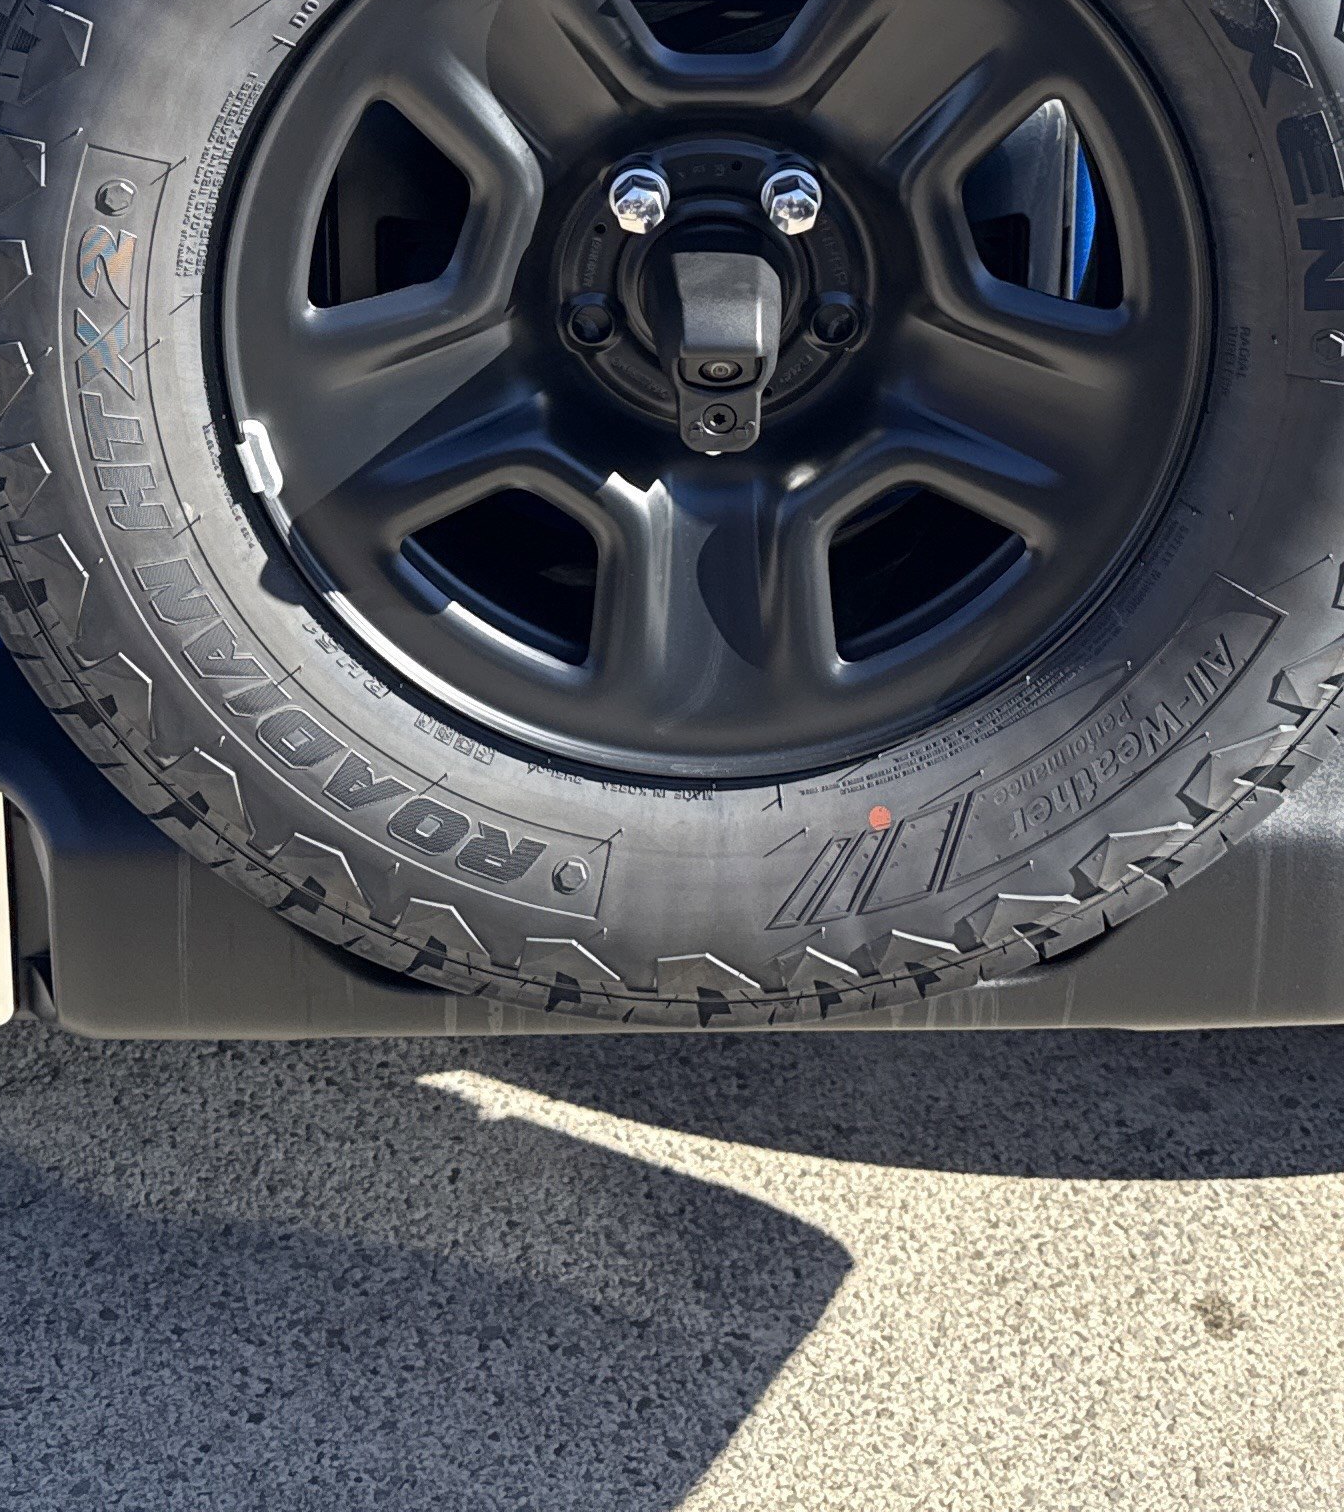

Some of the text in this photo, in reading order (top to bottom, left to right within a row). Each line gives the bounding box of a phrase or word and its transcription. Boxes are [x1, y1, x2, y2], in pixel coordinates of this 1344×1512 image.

[74, 224, 550, 884] ROADIAN HTX2
[992, 693, 1134, 806] Performance
[1010, 632, 1236, 840] All-Weather
